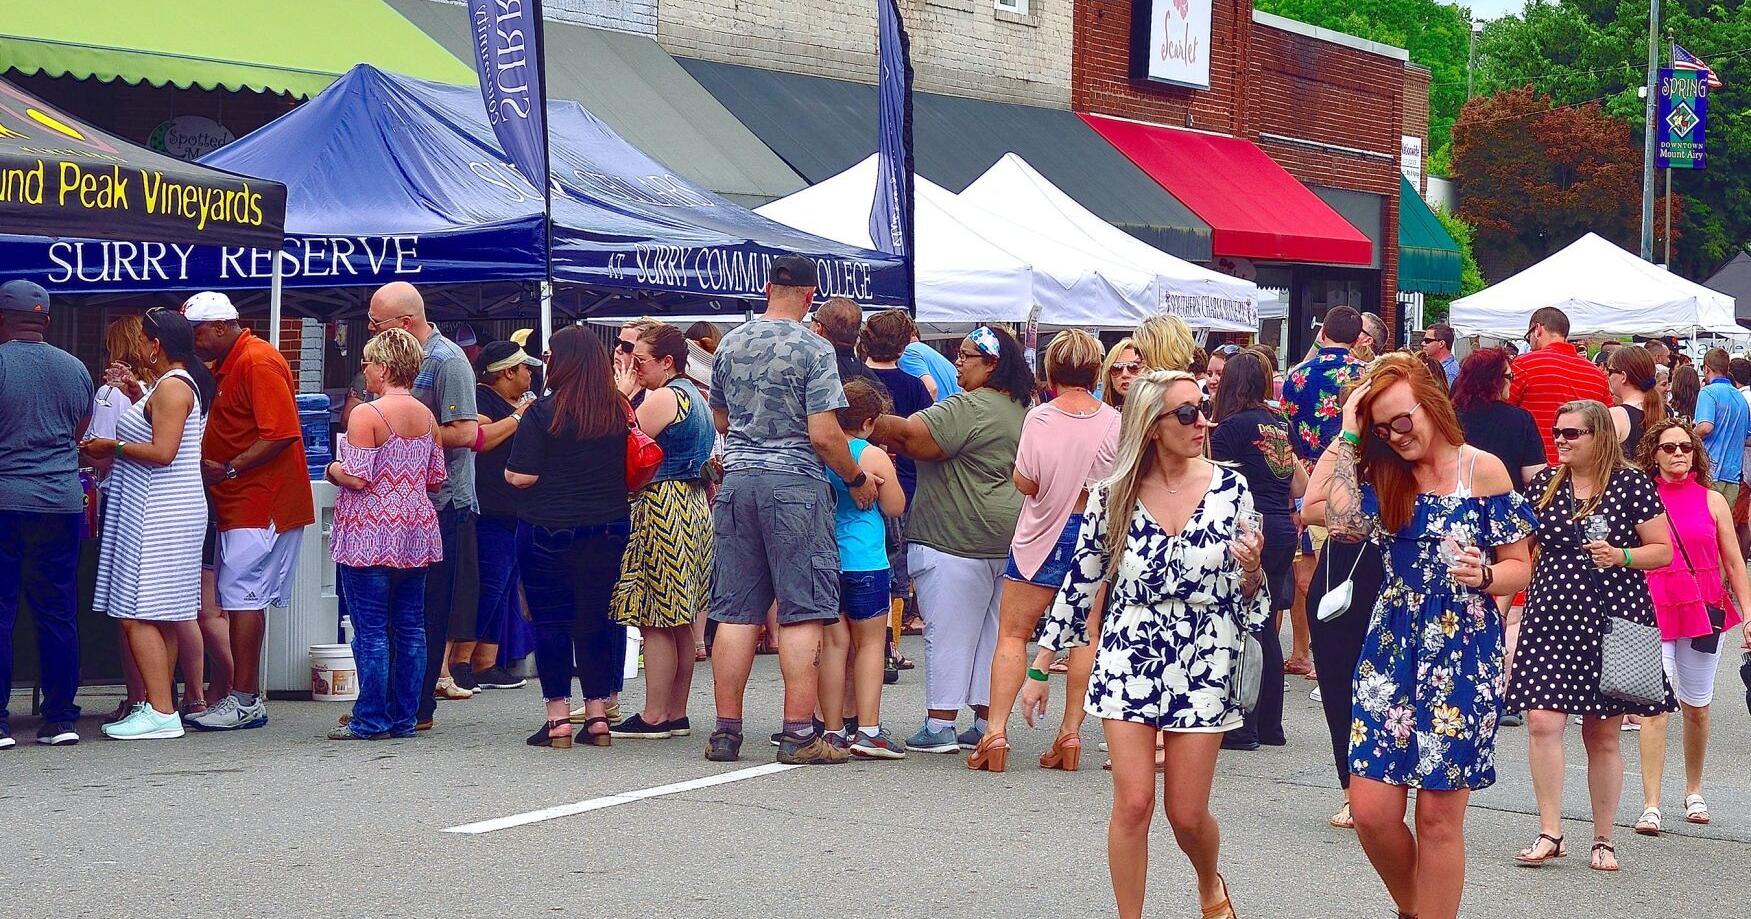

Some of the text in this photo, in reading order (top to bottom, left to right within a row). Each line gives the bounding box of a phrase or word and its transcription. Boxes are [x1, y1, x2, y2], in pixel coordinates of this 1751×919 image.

[1161, 10, 1199, 67] Scarlet
[1661, 77, 1707, 100] SPRING
[169, 128, 227, 149] Spotted
[1660, 149, 1704, 161] Mount Airy
[59, 161, 129, 211] Peak
[140, 168, 263, 231] Vineyards
[48, 235, 423, 283] SURRY RESERVE
[607, 243, 873, 300] AT SURRY COMMU OLLEGE
